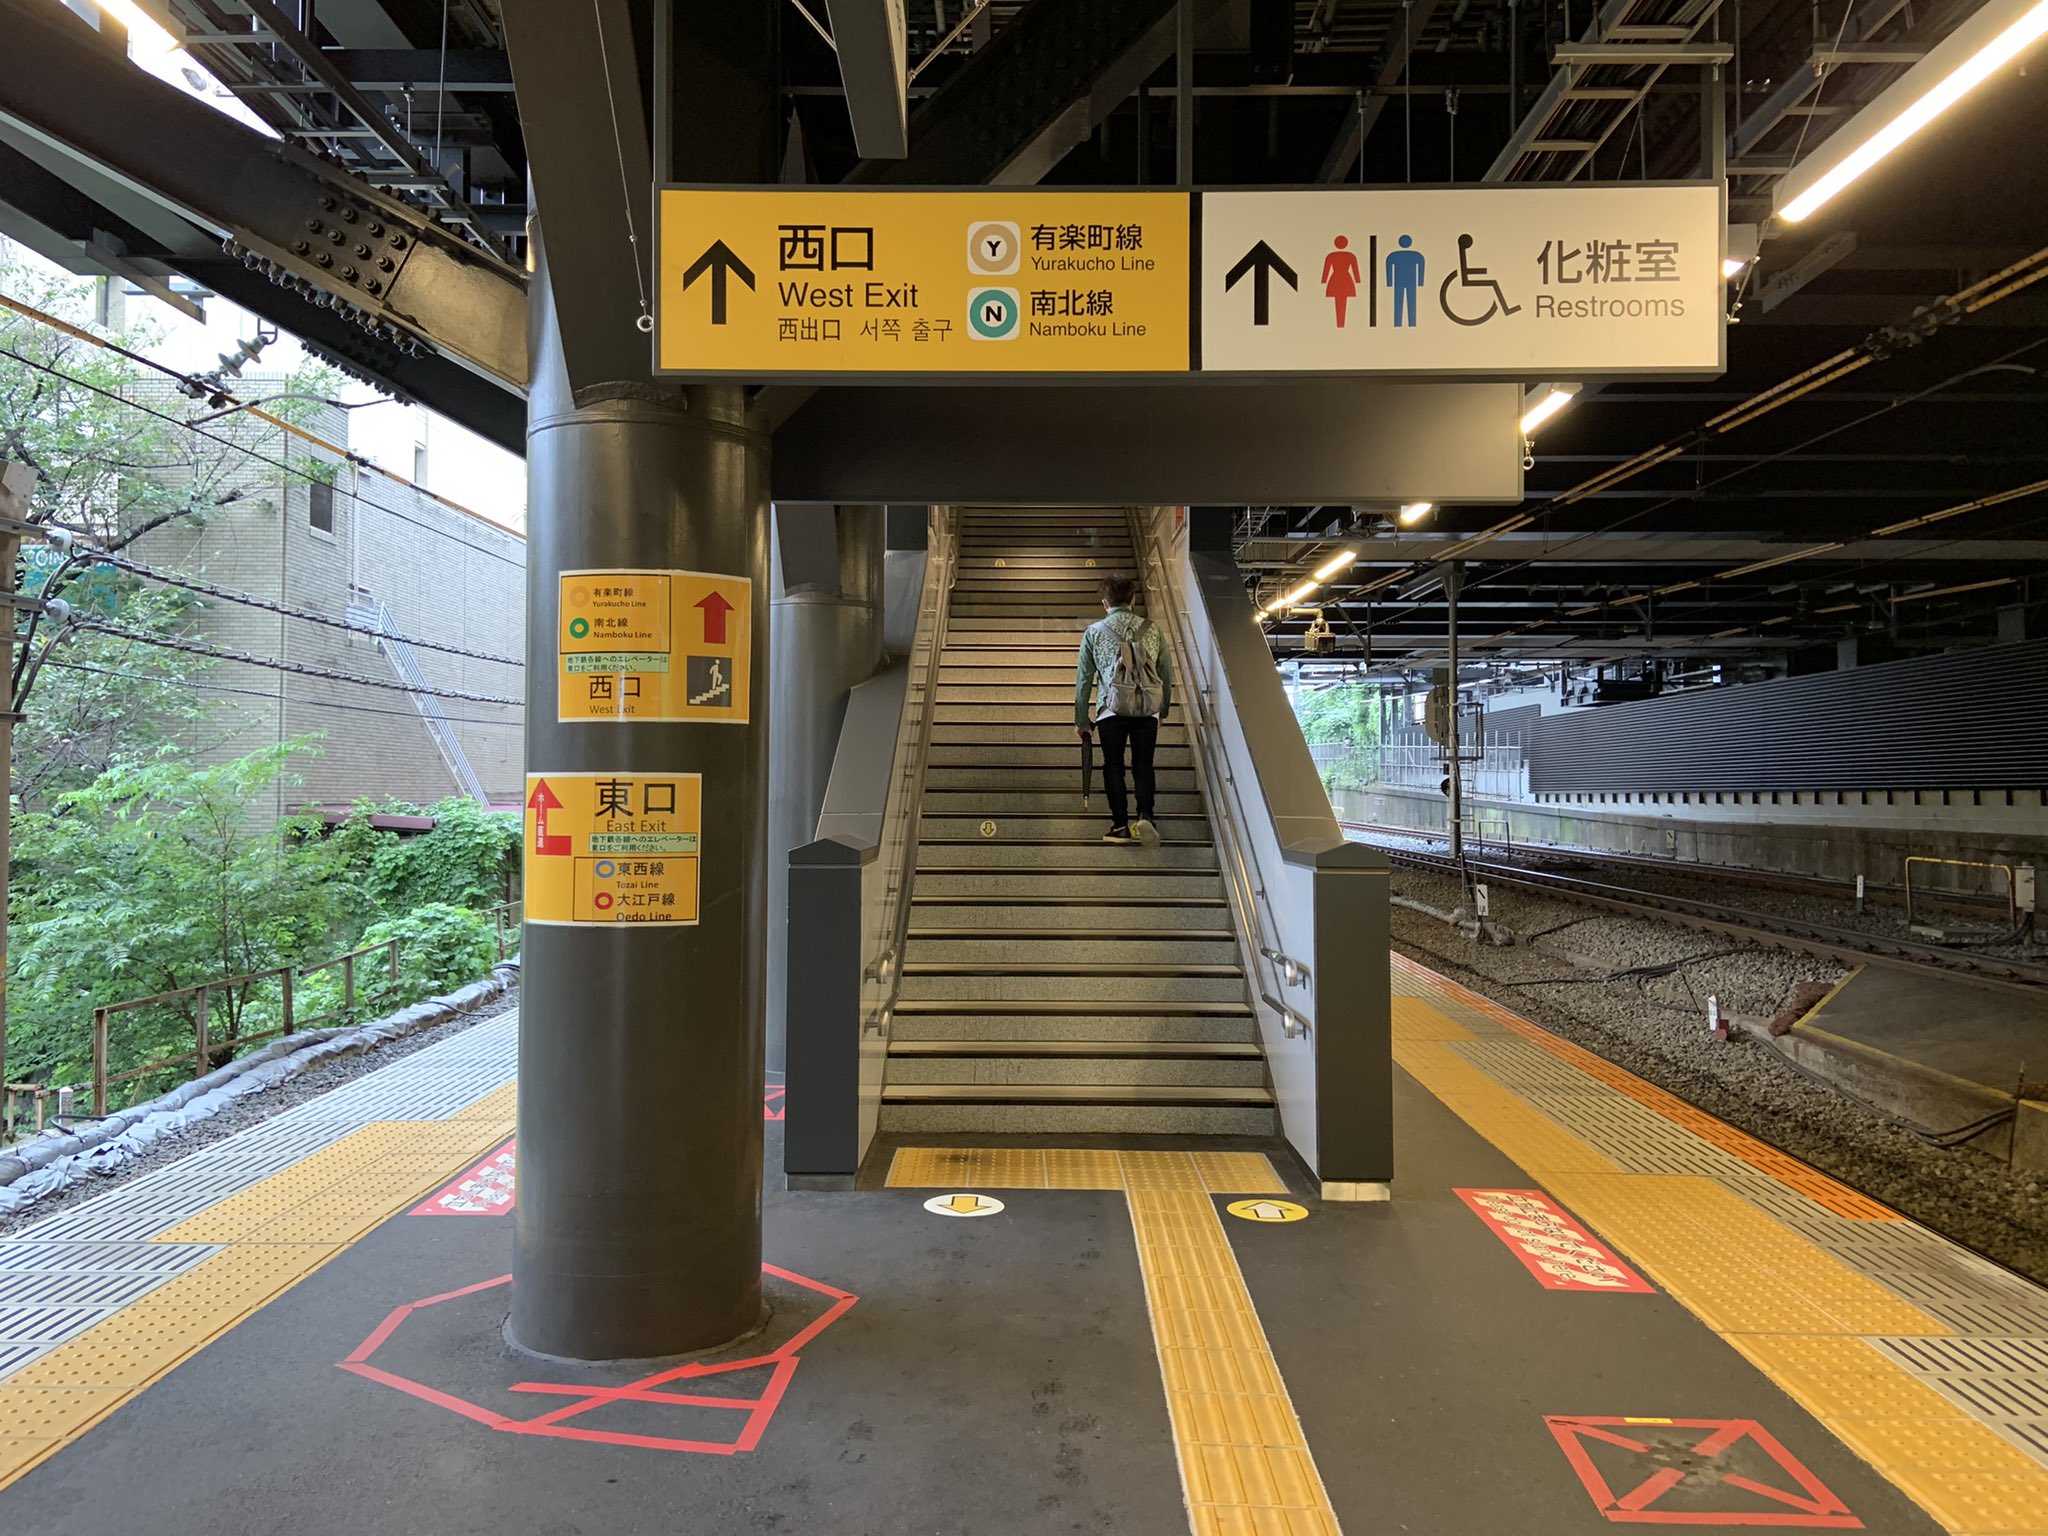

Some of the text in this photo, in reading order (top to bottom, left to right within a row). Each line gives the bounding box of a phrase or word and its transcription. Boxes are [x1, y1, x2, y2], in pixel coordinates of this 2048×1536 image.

[1030, 224, 1143, 251] 有楽町線
[778, 225, 874, 271] 西口
[986, 240, 1001, 257] Y
[1030, 257, 1155, 271] Yurakucho Line
[1536, 239, 1681, 285] 化粧室
[778, 282, 919, 308] West Exit
[1030, 290, 1114, 317] 南北線
[1536, 295, 1686, 319] Restrooms
[985, 306, 1002, 322] N
[778, 317, 841, 342] 西出口
[860, 318, 953, 342] 서쪽 출구
[1029, 322, 1146, 337] Namboku Line
[593, 588, 634, 597] 有楽町線
[594, 618, 628, 628] 南北線
[589, 675, 640, 699] 西口
[589, 705, 613, 714] West
[595, 778, 675, 818] 東口
[606, 820, 666, 832] East Exit
[617, 861, 664, 876] 東西線
[616, 881, 659, 889] Tozai Line
[617, 892, 675, 906] 大江戸線
[616, 912, 672, 922] Oedo Line
